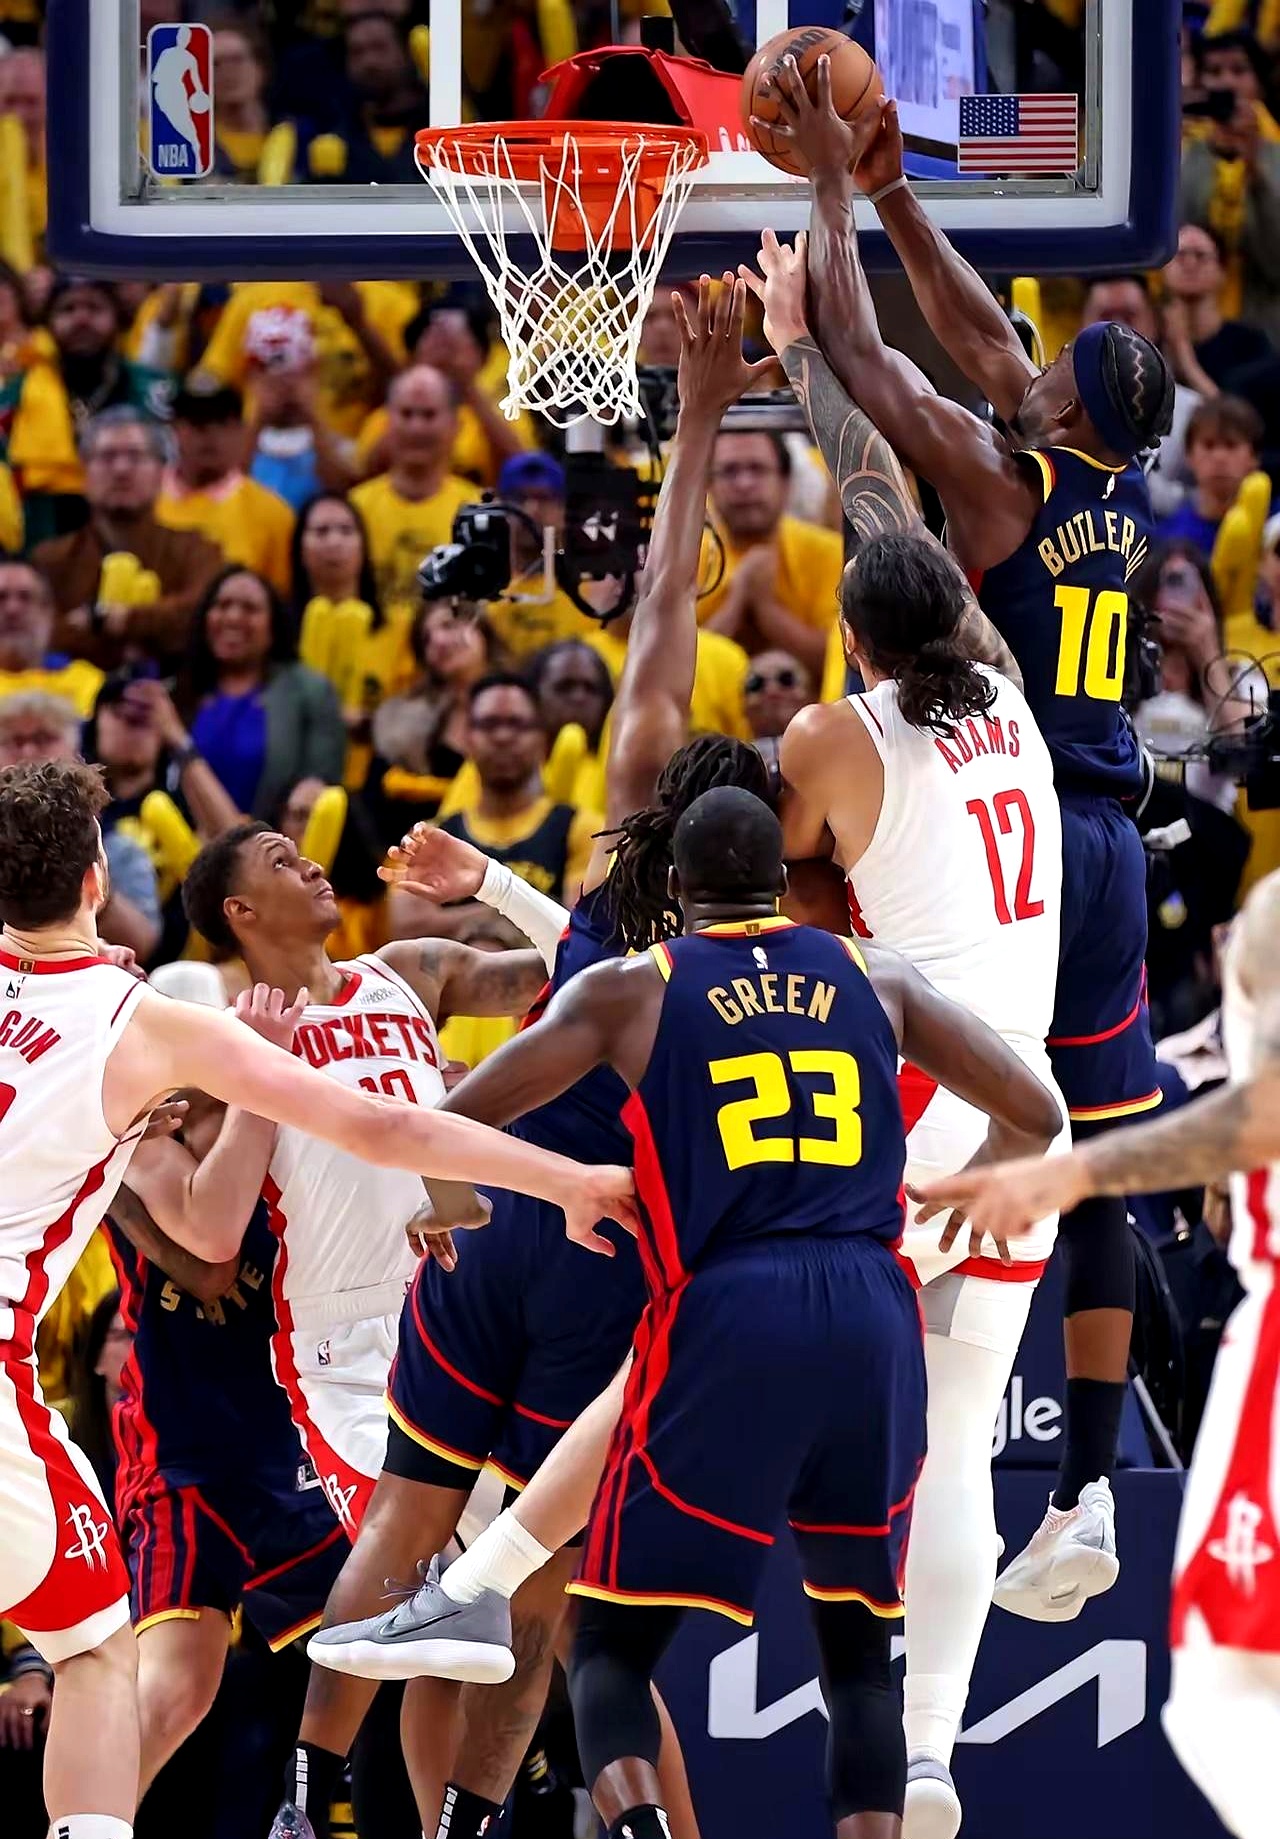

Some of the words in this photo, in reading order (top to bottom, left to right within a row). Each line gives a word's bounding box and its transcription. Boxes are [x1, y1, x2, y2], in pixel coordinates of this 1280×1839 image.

[158, 143, 189, 168] NBA
[1037, 509, 1136, 578] BUTLER
[1053, 584, 1129, 702] 10
[934, 716, 1020, 775] ADAMS
[965, 788, 1045, 925] 12
[706, 973, 837, 1026] GREEN
[291, 1013, 438, 1069] OCKETS
[708, 1050, 863, 1172] 23
